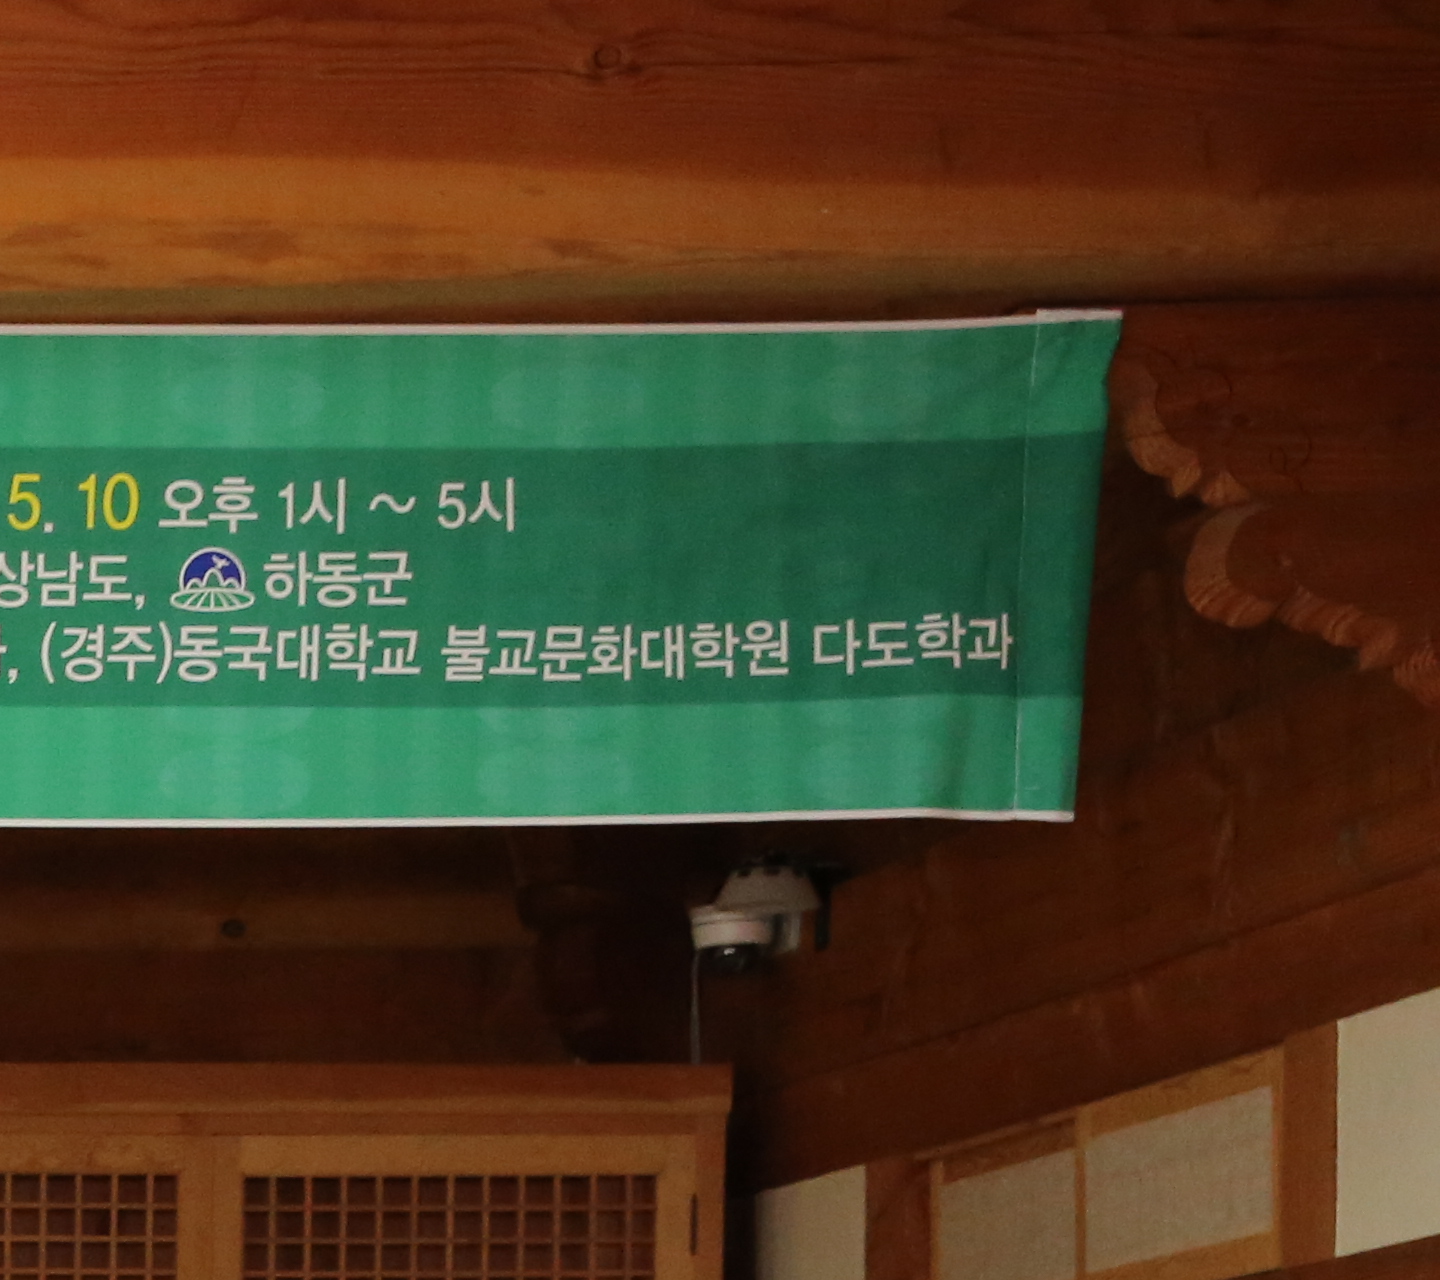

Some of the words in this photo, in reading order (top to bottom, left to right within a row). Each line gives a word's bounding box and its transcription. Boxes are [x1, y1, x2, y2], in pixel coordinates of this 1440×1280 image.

[4, 472, 58, 532] 5.
[75, 472, 141, 531] 10
[158, 477, 259, 533] 오후
[276, 477, 348, 533] 1시
[435, 477, 516, 533] 5시
[263, 552, 412, 607] 하동군
[38, 621, 422, 687] (경주)동국대학교
[440, 619, 790, 681] 불교문화대학원
[810, 612, 1014, 674] 다도학과
